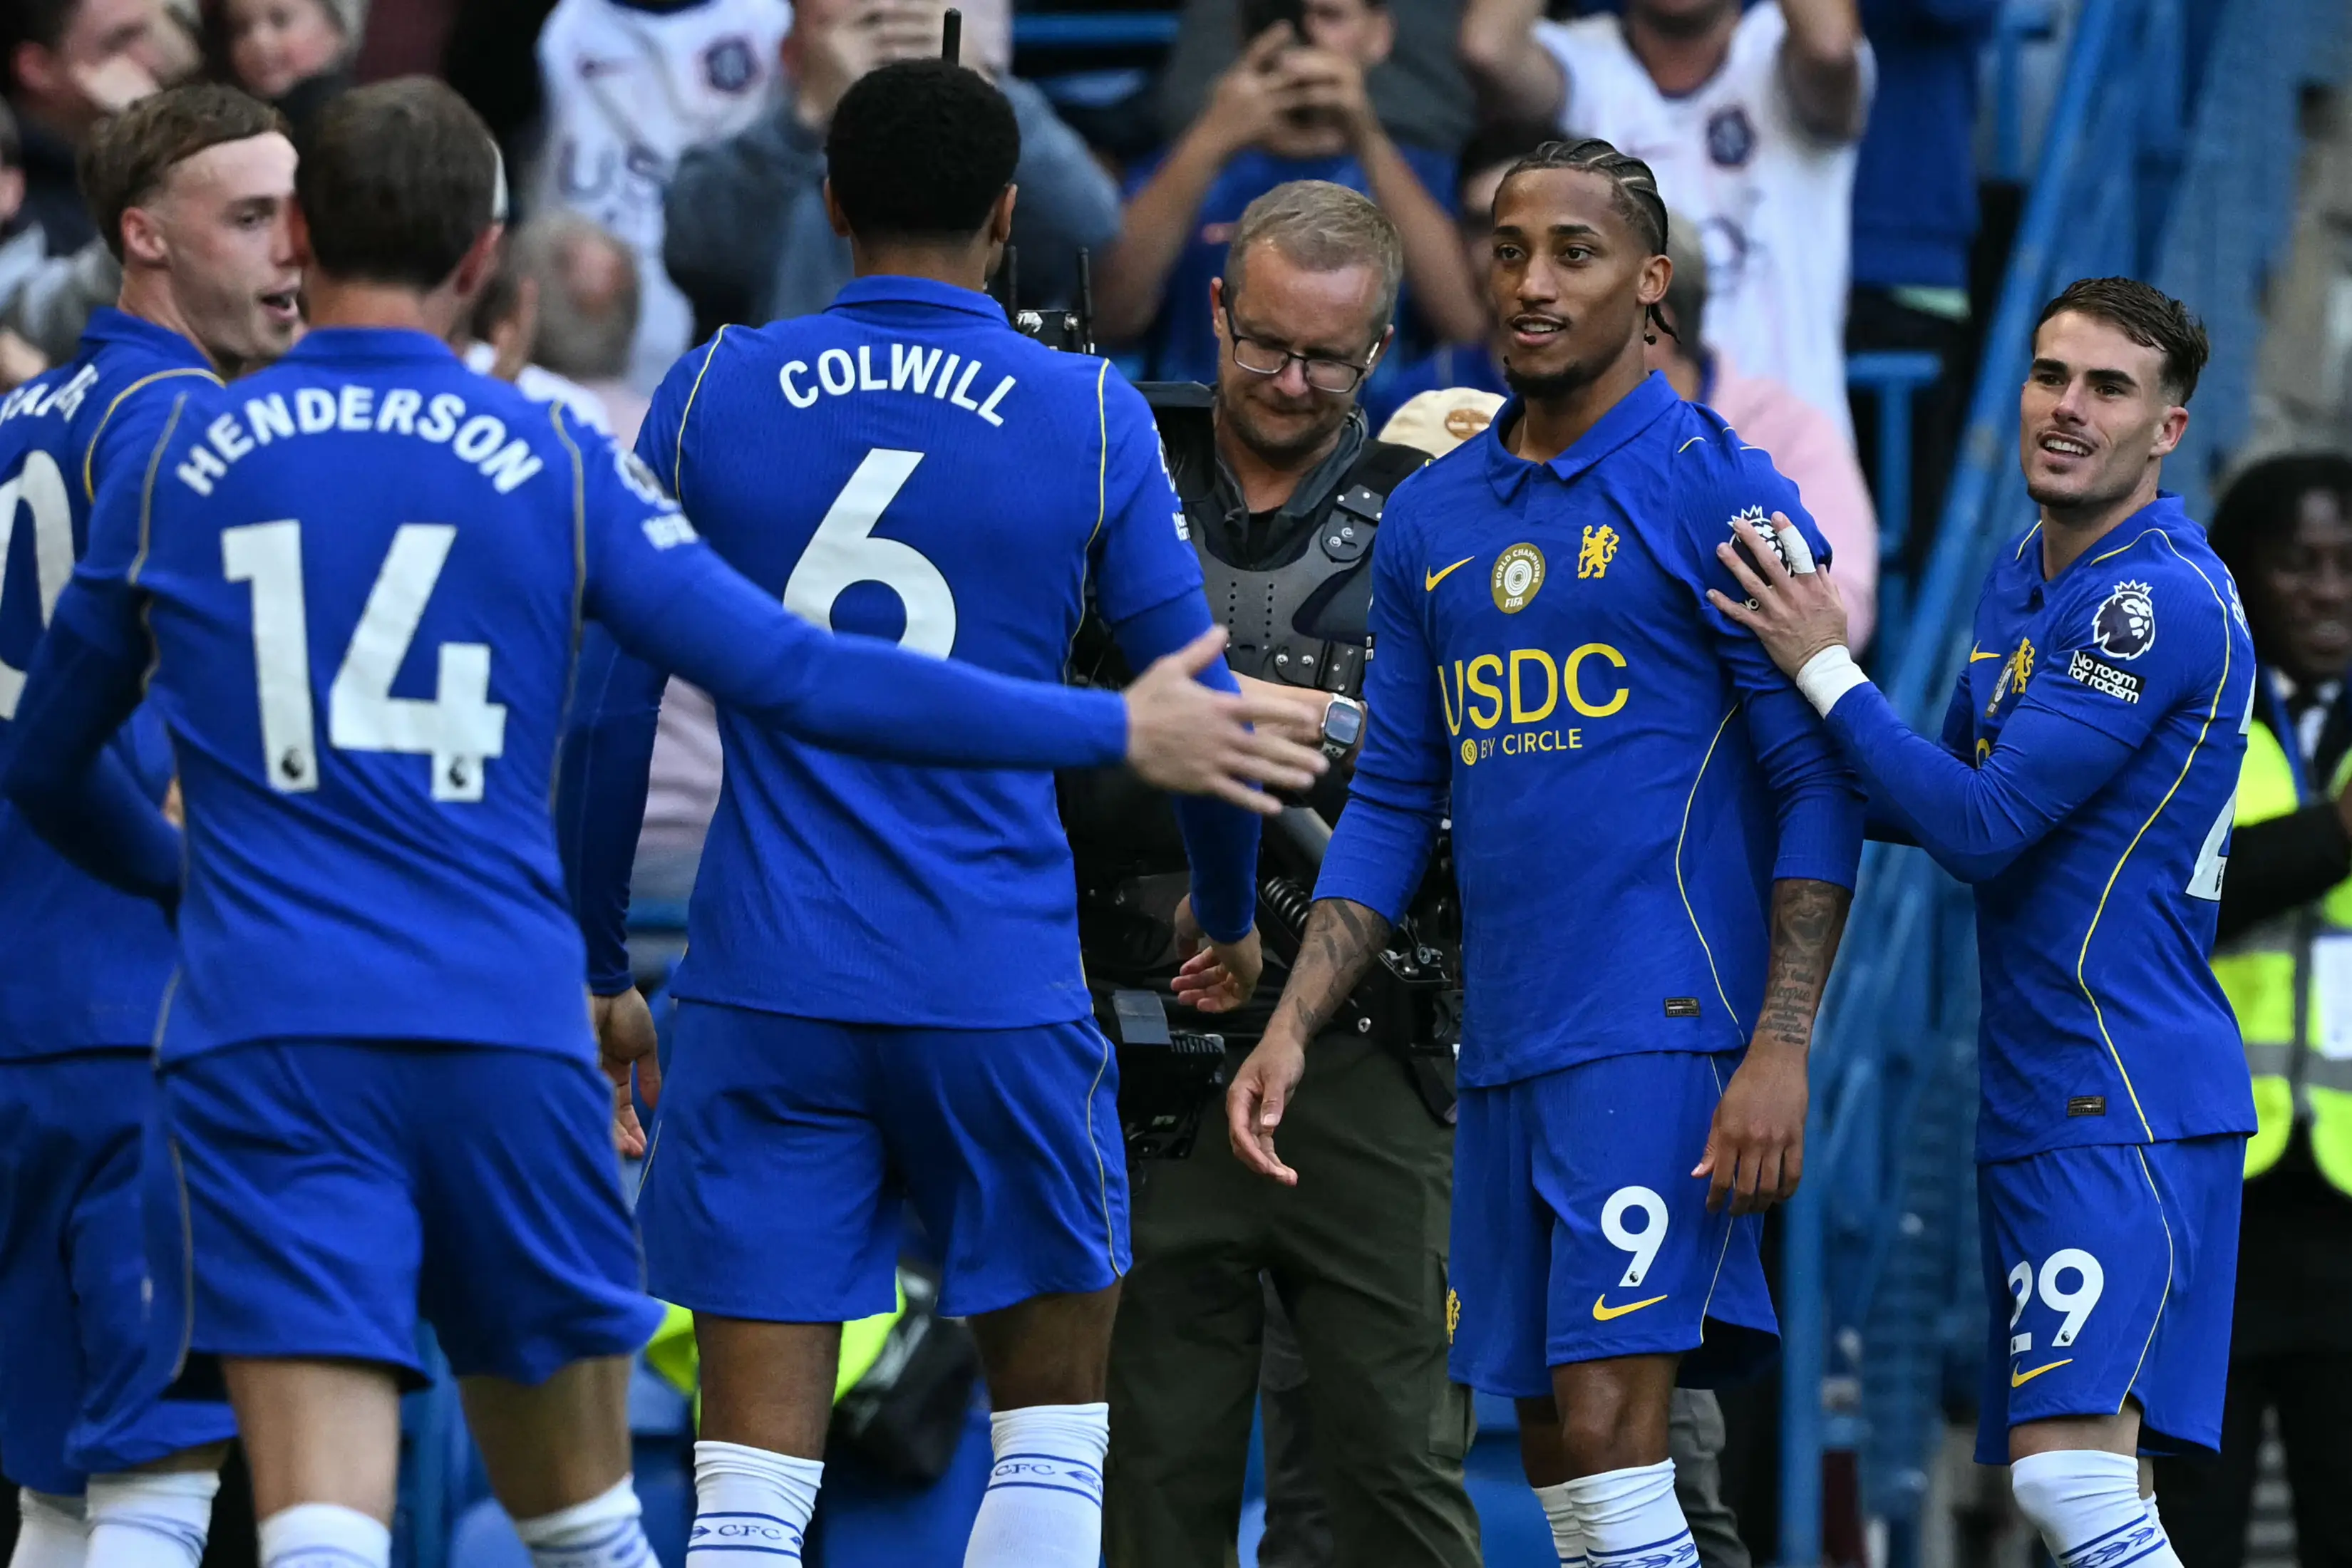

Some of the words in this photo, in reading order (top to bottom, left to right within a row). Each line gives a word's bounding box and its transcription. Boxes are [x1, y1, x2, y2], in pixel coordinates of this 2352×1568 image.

[779, 344, 1016, 427] COLWILL
[176, 385, 543, 496] HENDERSON
[783, 447, 956, 661] 6
[1495, 555, 1511, 589] WORLD
[1512, 548, 1541, 583] CHAMPIONS
[1505, 597, 1524, 608] FIFA
[220, 519, 507, 802] 14
[1437, 642, 1629, 736] USDC
[2068, 649, 2094, 676] No
[2094, 663, 2137, 690] room
[2088, 674, 2140, 704] racism
[1480, 738, 1496, 759] BY
[1502, 728, 1583, 755] CIRCLE
[1601, 1185, 1668, 1287] 9
[2009, 1248, 2104, 1356] 29
[995, 1463, 1056, 1477] CFC
[718, 1524, 783, 1540] CFC
